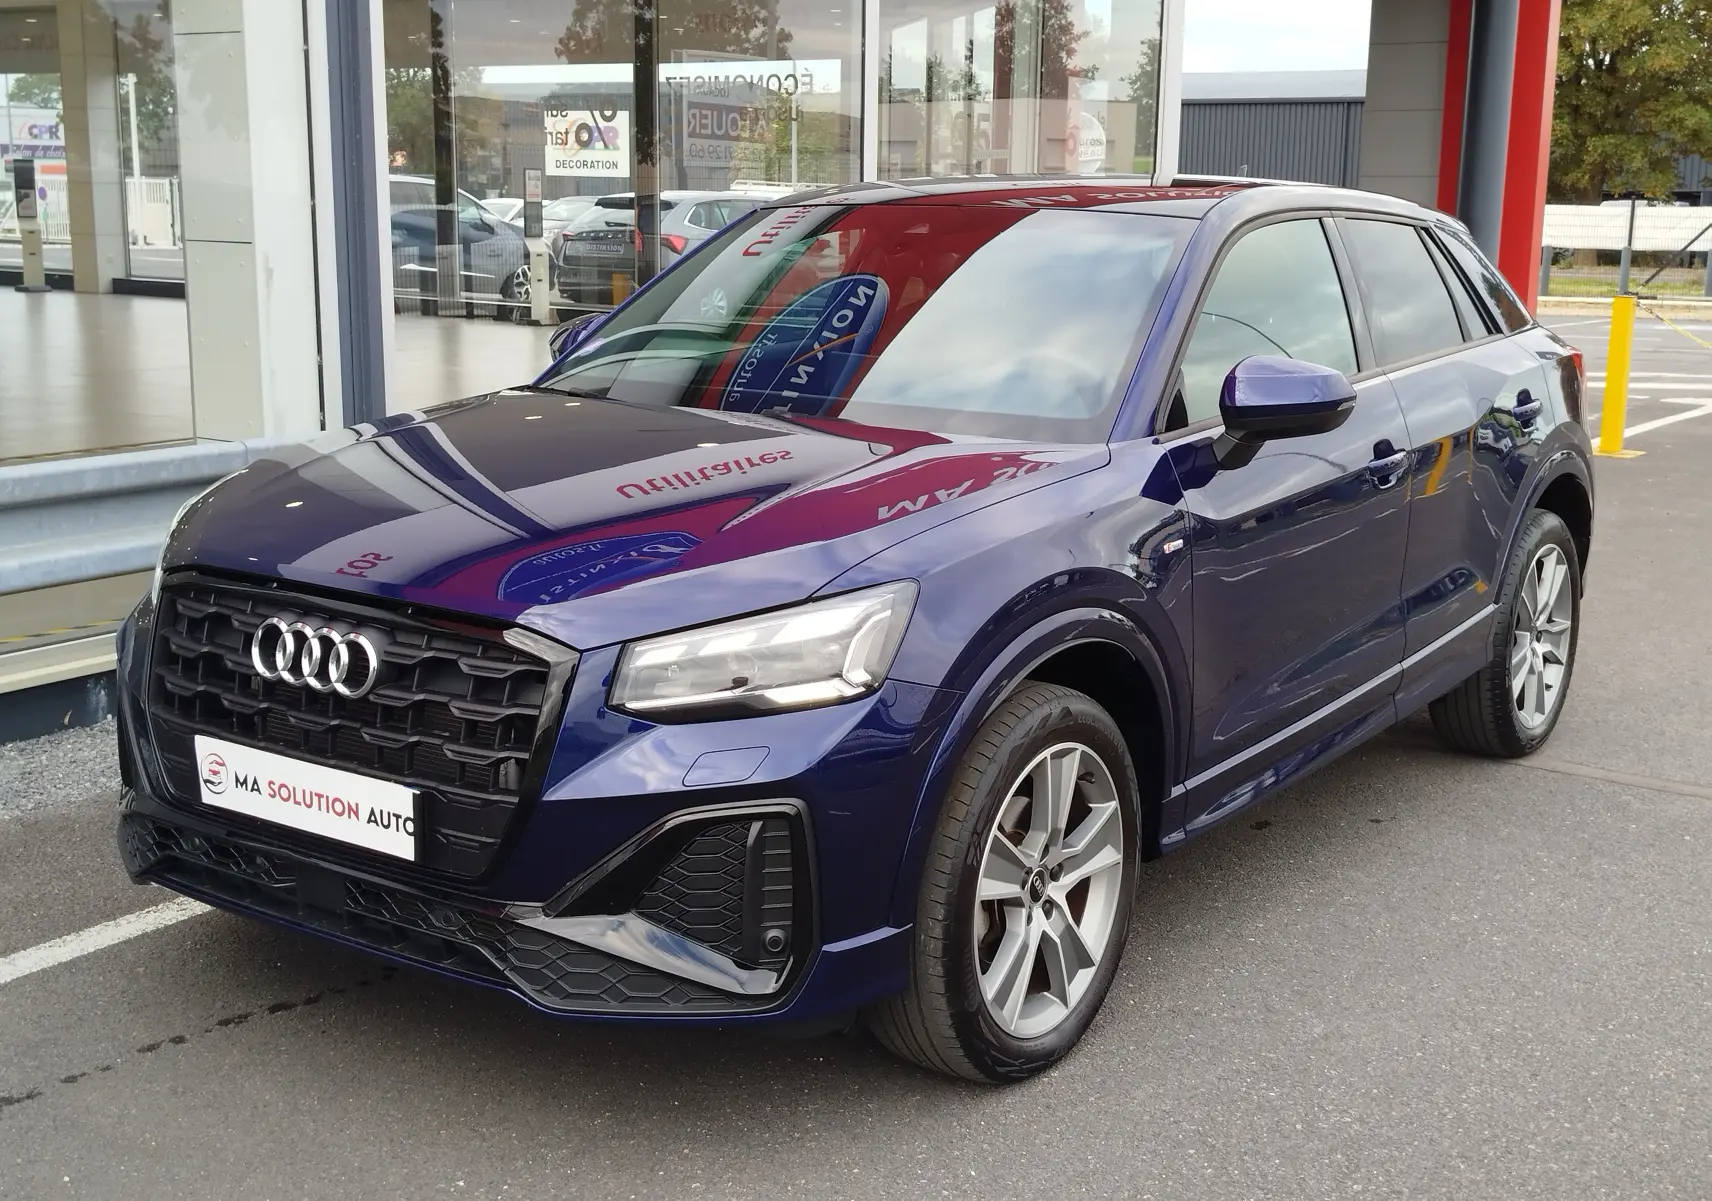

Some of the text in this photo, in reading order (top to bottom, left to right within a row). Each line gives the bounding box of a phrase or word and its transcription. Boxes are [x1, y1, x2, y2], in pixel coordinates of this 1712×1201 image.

[28, 124, 61, 140] CPR
[555, 159, 619, 170] DECORATION
[234, 771, 262, 796] MA
[267, 779, 360, 822] SOLUTION
